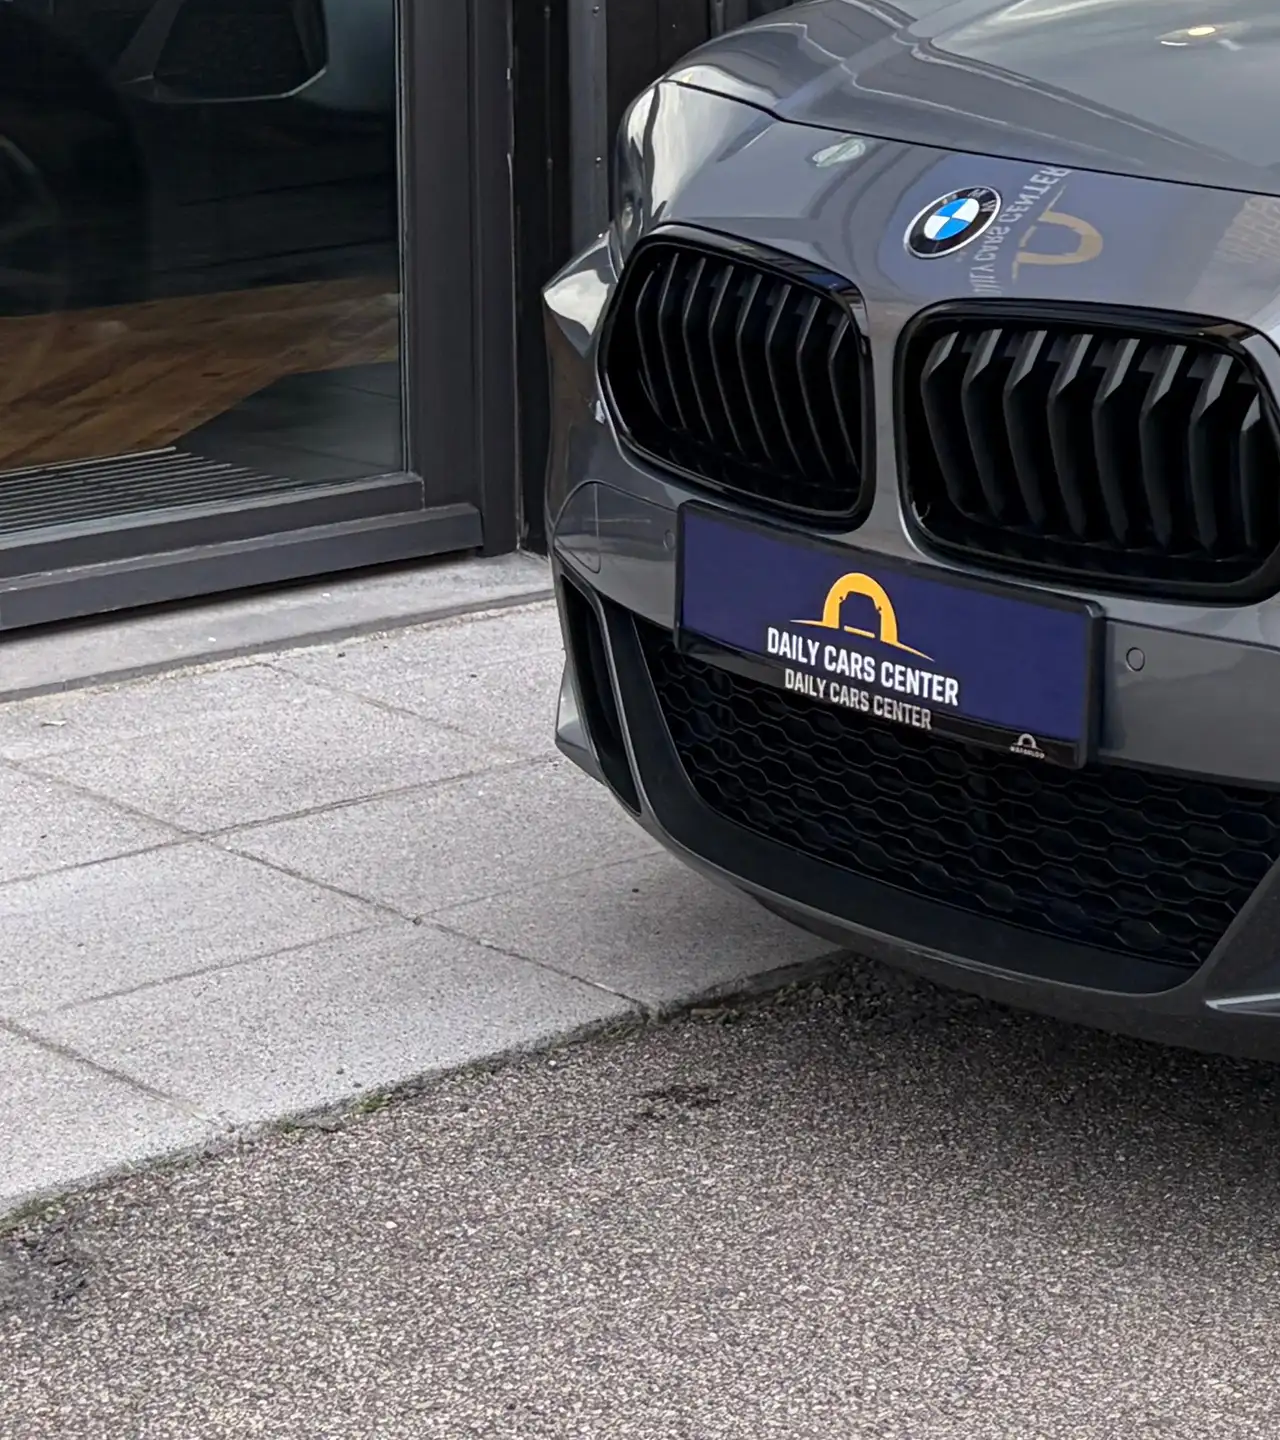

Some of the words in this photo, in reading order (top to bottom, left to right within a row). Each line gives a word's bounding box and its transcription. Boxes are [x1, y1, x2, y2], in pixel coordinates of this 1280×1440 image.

[766, 626, 821, 669] DAILY
[823, 643, 876, 683] CARS
[880, 661, 961, 707] CENTER
[784, 667, 827, 702] DAILY
[828, 680, 871, 713] CARS
[872, 696, 933, 731] CENTER
